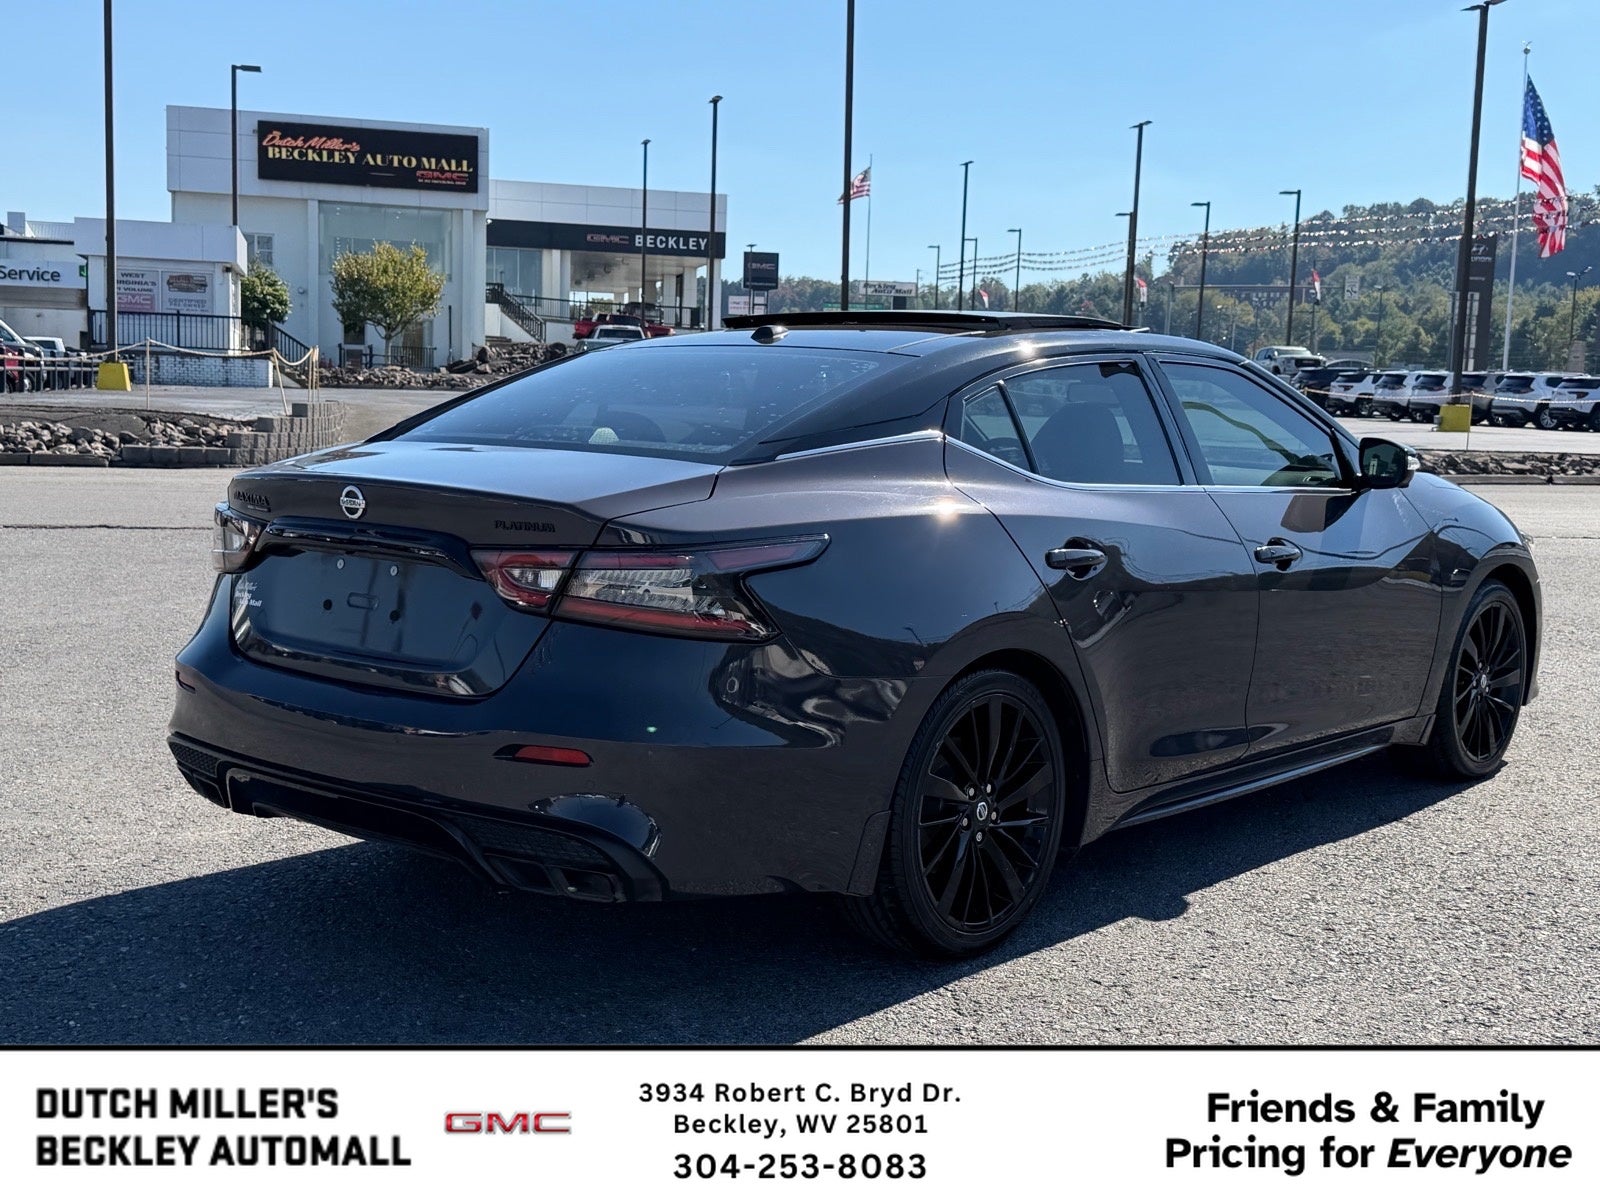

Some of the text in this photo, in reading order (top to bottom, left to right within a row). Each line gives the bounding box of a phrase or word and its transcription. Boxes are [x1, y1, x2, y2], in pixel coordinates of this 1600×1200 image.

[262, 131, 360, 152] Dutch Miller's
[267, 146, 473, 172] BECKLEY AUTO MALL
[416, 170, 469, 181] GMC
[587, 233, 708, 251] GMC BECKLEY
[0, 265, 61, 282] Service
[117, 279, 157, 287] IRGINIA'S
[234, 489, 271, 507] MAXIMA
[494, 519, 556, 533] PLATINUM
